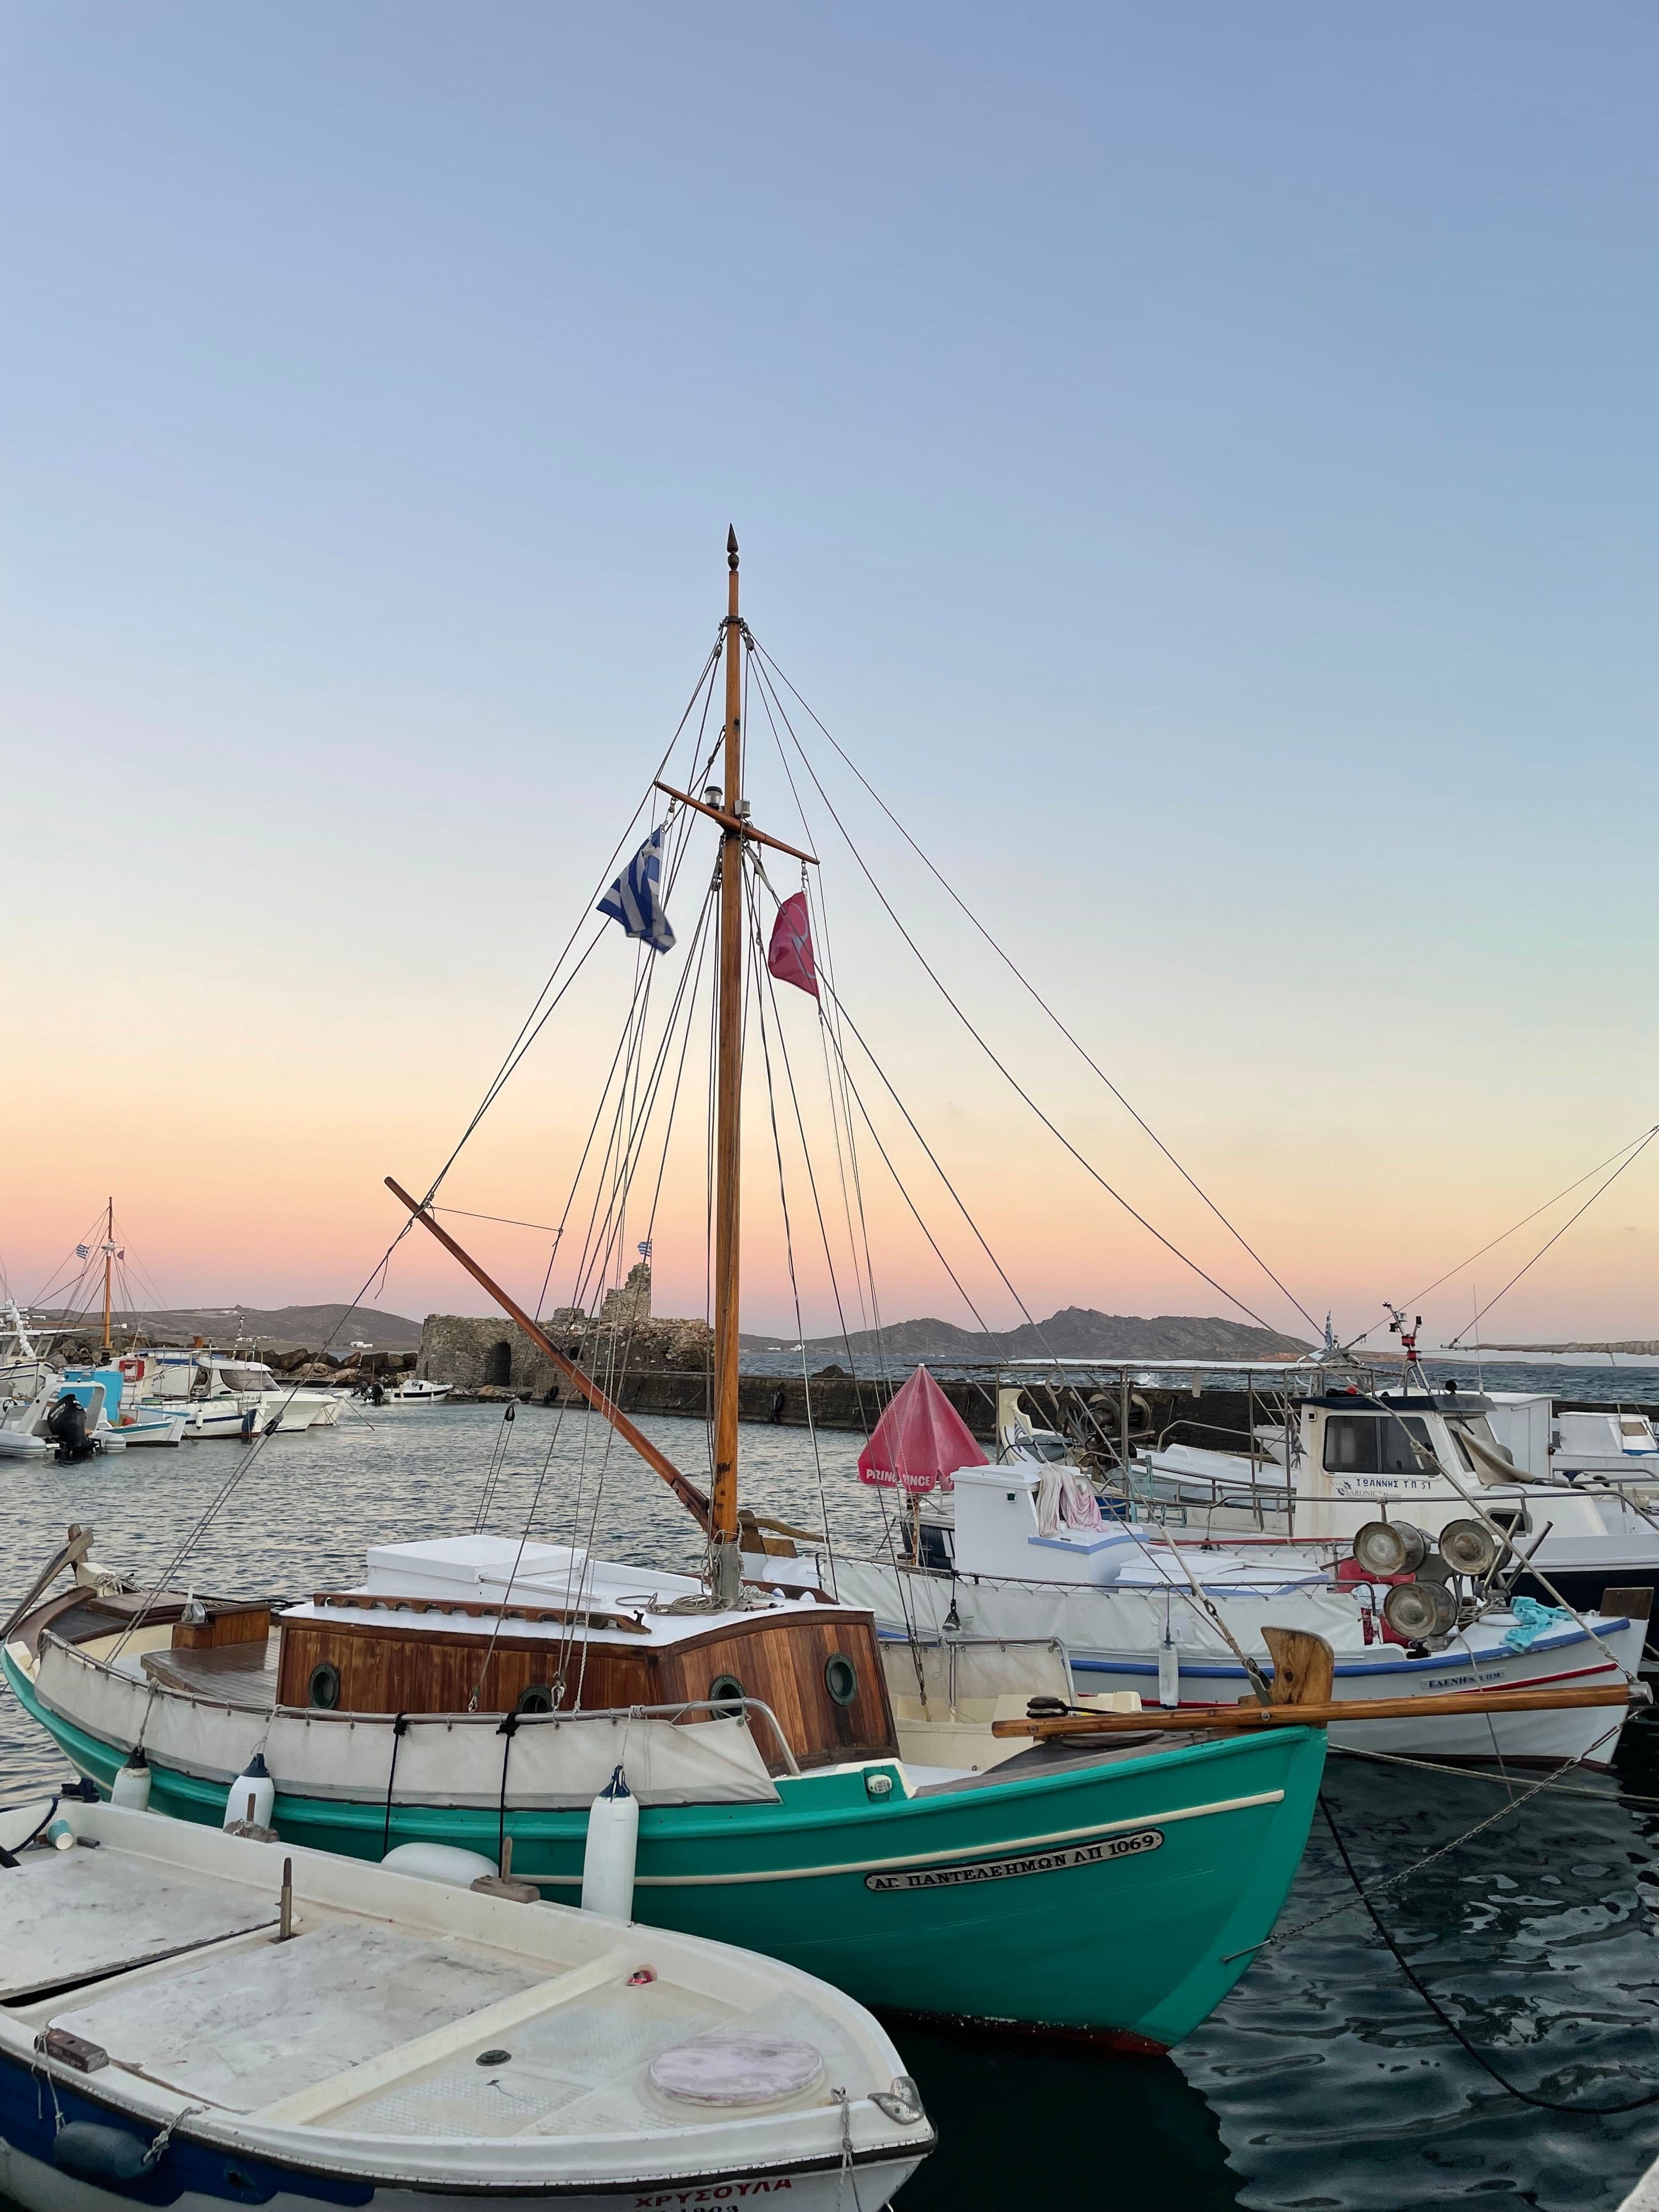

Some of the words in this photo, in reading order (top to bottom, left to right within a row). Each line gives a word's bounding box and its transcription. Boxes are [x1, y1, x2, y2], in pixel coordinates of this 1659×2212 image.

[1356, 1479, 1398, 1488] ΙΩΑΝΝΗΣ
[875, 1877, 900, 1889] ΑΓ.
[907, 1853, 1066, 1886] ΠΑΝΤΕΛΕΗΜΩΝ
[1108, 1834, 1154, 1855] 1069
[634, 2179, 793, 2208] ΧΡΥΣΟΥΛΑ
